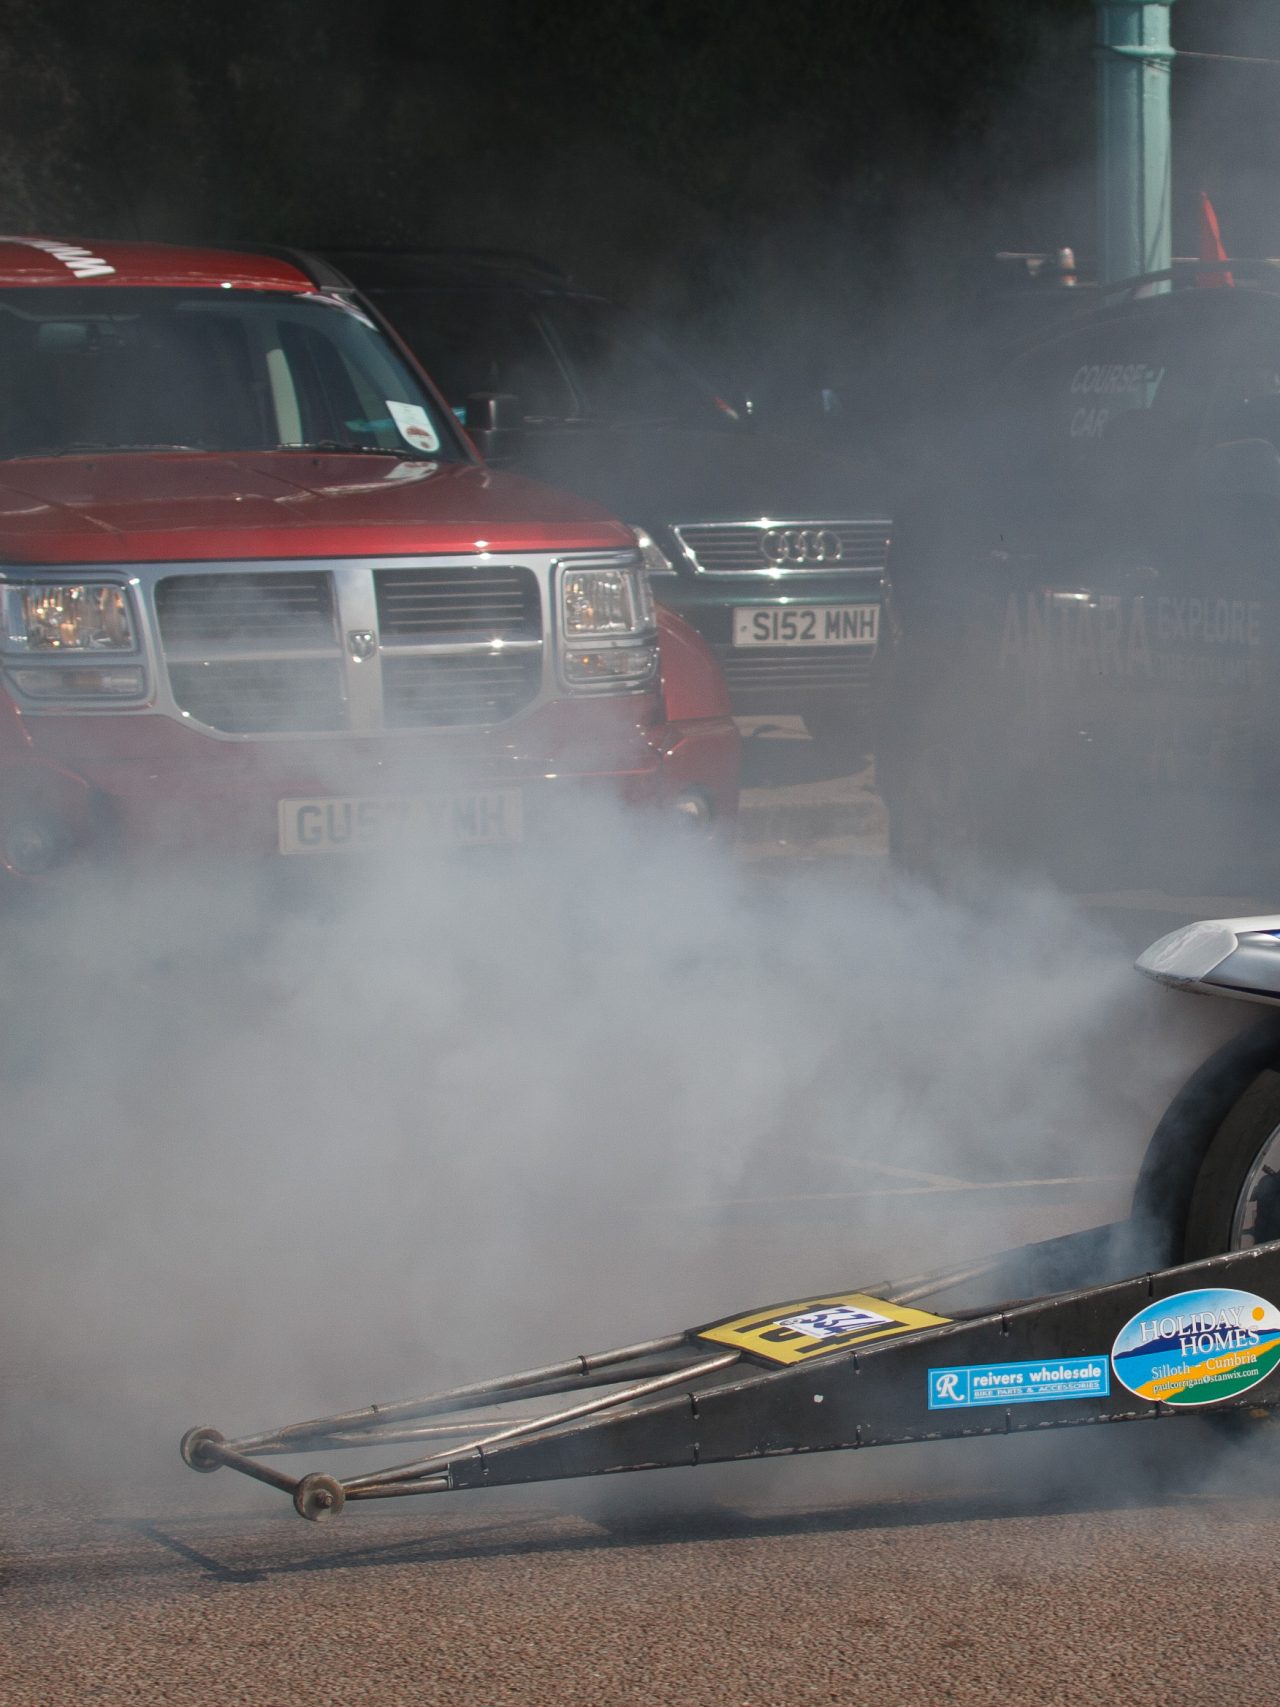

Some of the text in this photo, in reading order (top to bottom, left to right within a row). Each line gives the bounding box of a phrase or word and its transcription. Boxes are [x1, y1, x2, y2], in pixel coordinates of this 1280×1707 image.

[1070, 363, 1148, 395] COURSE
[1070, 407, 1110, 439] CAR
[825, 609, 877, 640] MNH
[1157, 596, 1262, 646] EXPLORE
[1140, 1305, 1245, 1343] HOLIDAY
[1179, 1325, 1260, 1357] HOMES
[973, 1364, 1101, 1387] reivers wholesale
[1151, 1361, 1191, 1380] Silloth
[1205, 1351, 1258, 1371] Cumbria
[973, 1388, 993, 1398] BIKE
[997, 1387, 1023, 1397] PARTS
[1039, 1381, 1100, 1393] ACCESSORIES
